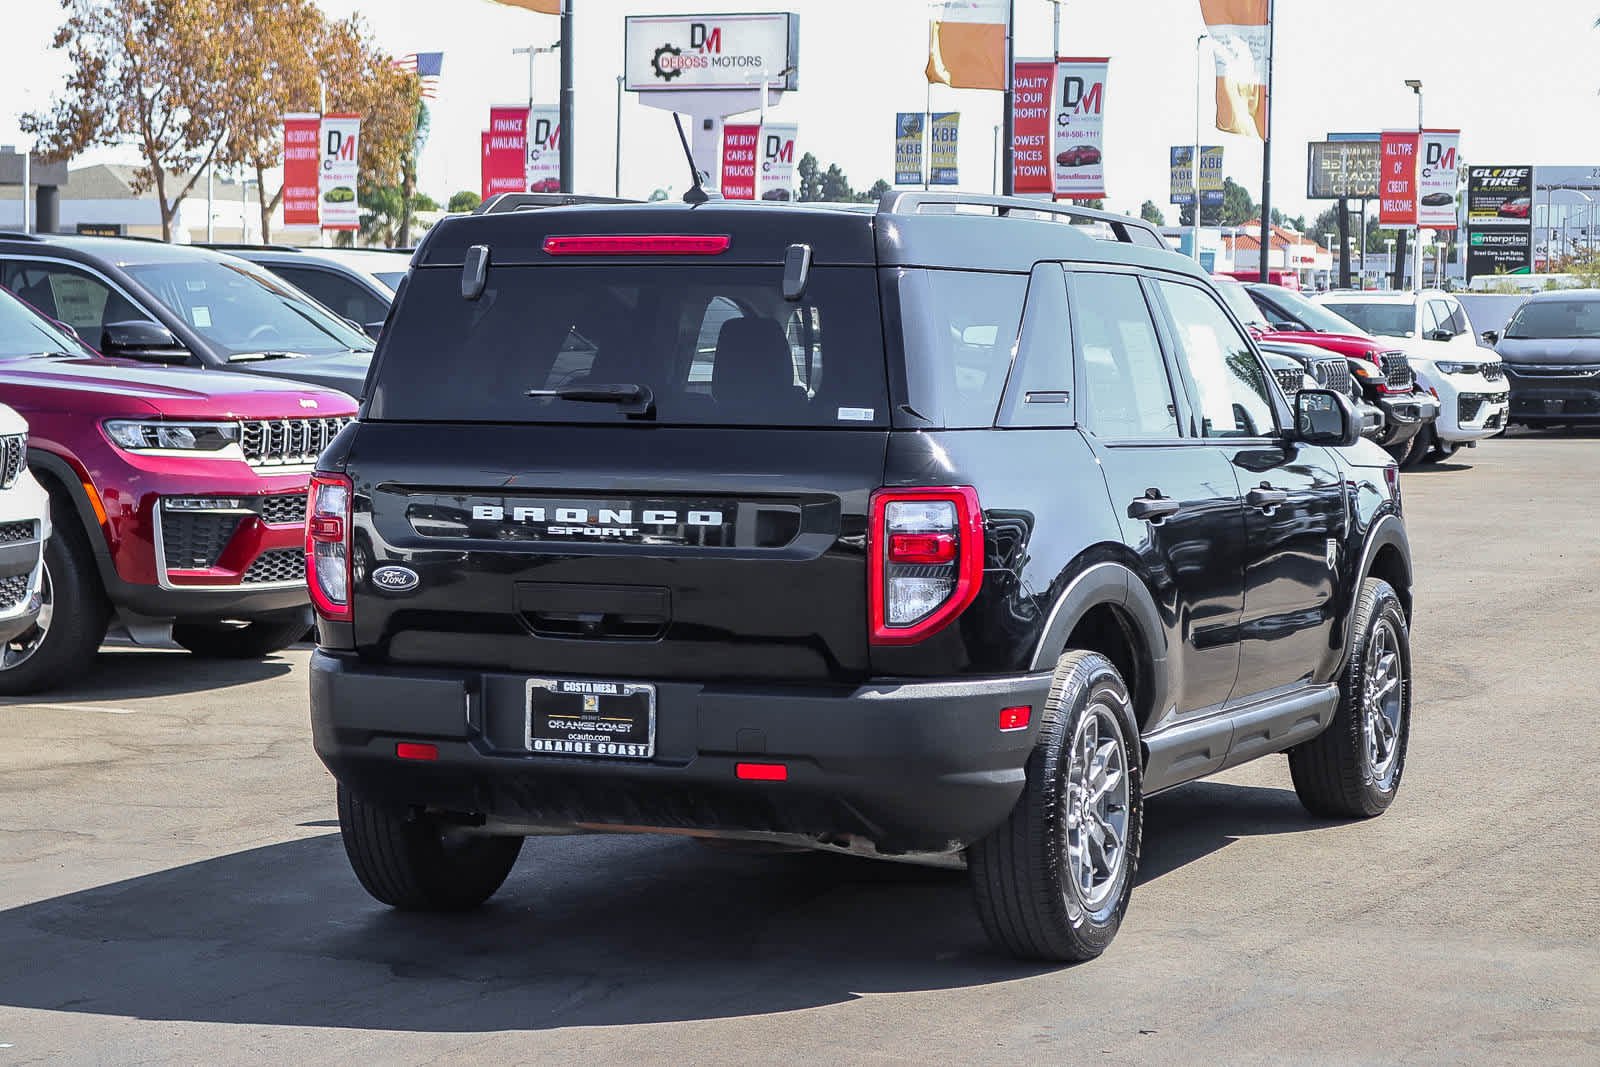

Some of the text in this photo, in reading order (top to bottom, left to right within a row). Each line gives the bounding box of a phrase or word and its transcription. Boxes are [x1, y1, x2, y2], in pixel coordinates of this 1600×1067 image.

[691, 23, 721, 54] DM
[661, 55, 762, 69] DEBOSS MOTORS
[1014, 78, 1048, 88] UALITY
[1023, 92, 1043, 103] OUR
[1063, 76, 1103, 114] DM
[1013, 108, 1048, 119] RIORITY
[494, 119, 523, 131] FINANCE
[727, 135, 756, 145] WE BUY
[932, 127, 958, 142] KBB
[1014, 135, 1045, 146] OWEST
[328, 130, 355, 160] DM
[491, 136, 524, 149] AVAILABLE
[726, 150, 746, 160] CARS
[766, 135, 794, 163] DM
[1386, 143, 1396, 155] ALL
[1397, 143, 1413, 156] TYPE
[1426, 142, 1456, 170] DM
[725, 165, 754, 176] TRUCKS
[1019, 166, 1047, 176] TOWN
[1394, 162, 1403, 174] OF
[1472, 168, 1528, 177] GLOBE
[1387, 181, 1408, 193] CREDIT
[1481, 177, 1520, 186] TIRE
[1383, 200, 1413, 212] WELCOME
[1473, 234, 1527, 244] enterprise
[472, 505, 723, 526] BRONCO
[547, 526, 639, 537] SPORT
[563, 681, 617, 694] COSTA MESA
[548, 720, 633, 733] ORANGE COAST
[568, 733, 611, 742] ocauto.com
[534, 740, 646, 756] ORANGE COAST
